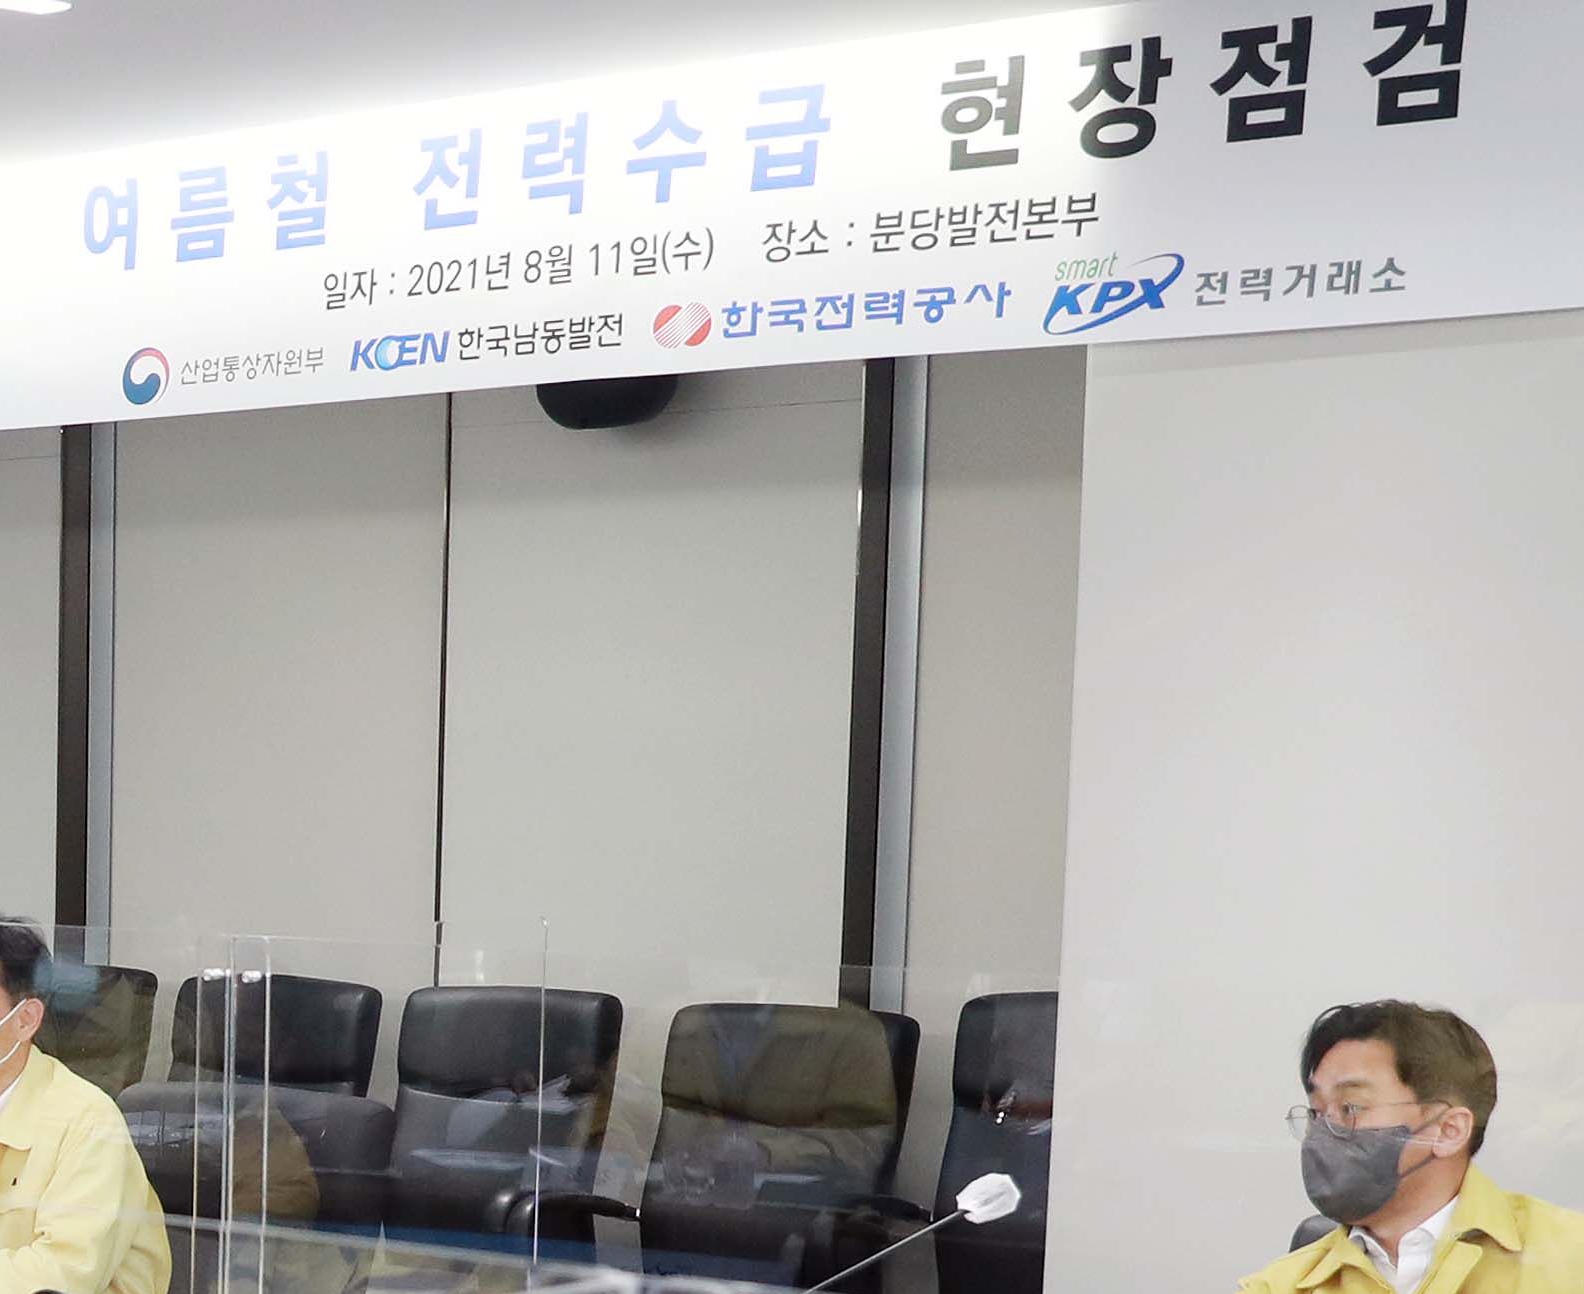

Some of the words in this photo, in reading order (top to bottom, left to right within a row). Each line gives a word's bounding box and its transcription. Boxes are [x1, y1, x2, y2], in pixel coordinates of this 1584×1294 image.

[83, 150, 330, 272] 여름철
[413, 83, 831, 232] 전력수급
[939, 0, 1469, 172] 현장점검
[322, 271, 378, 310] 일자
[406, 252, 512, 299] 2021년
[523, 244, 574, 286] 8월
[588, 226, 715, 278] 11일(수)
[762, 216, 830, 262] 장소
[868, 193, 1100, 255] 분당발전본부
[1054, 252, 1119, 282] smart
[721, 280, 1012, 339] 한국전력공사
[1043, 270, 1173, 328] KPX
[1194, 256, 1407, 308] 전력거래소
[178, 344, 325, 387] 산업통상자원부
[456, 311, 624, 362] 한국남동발전
